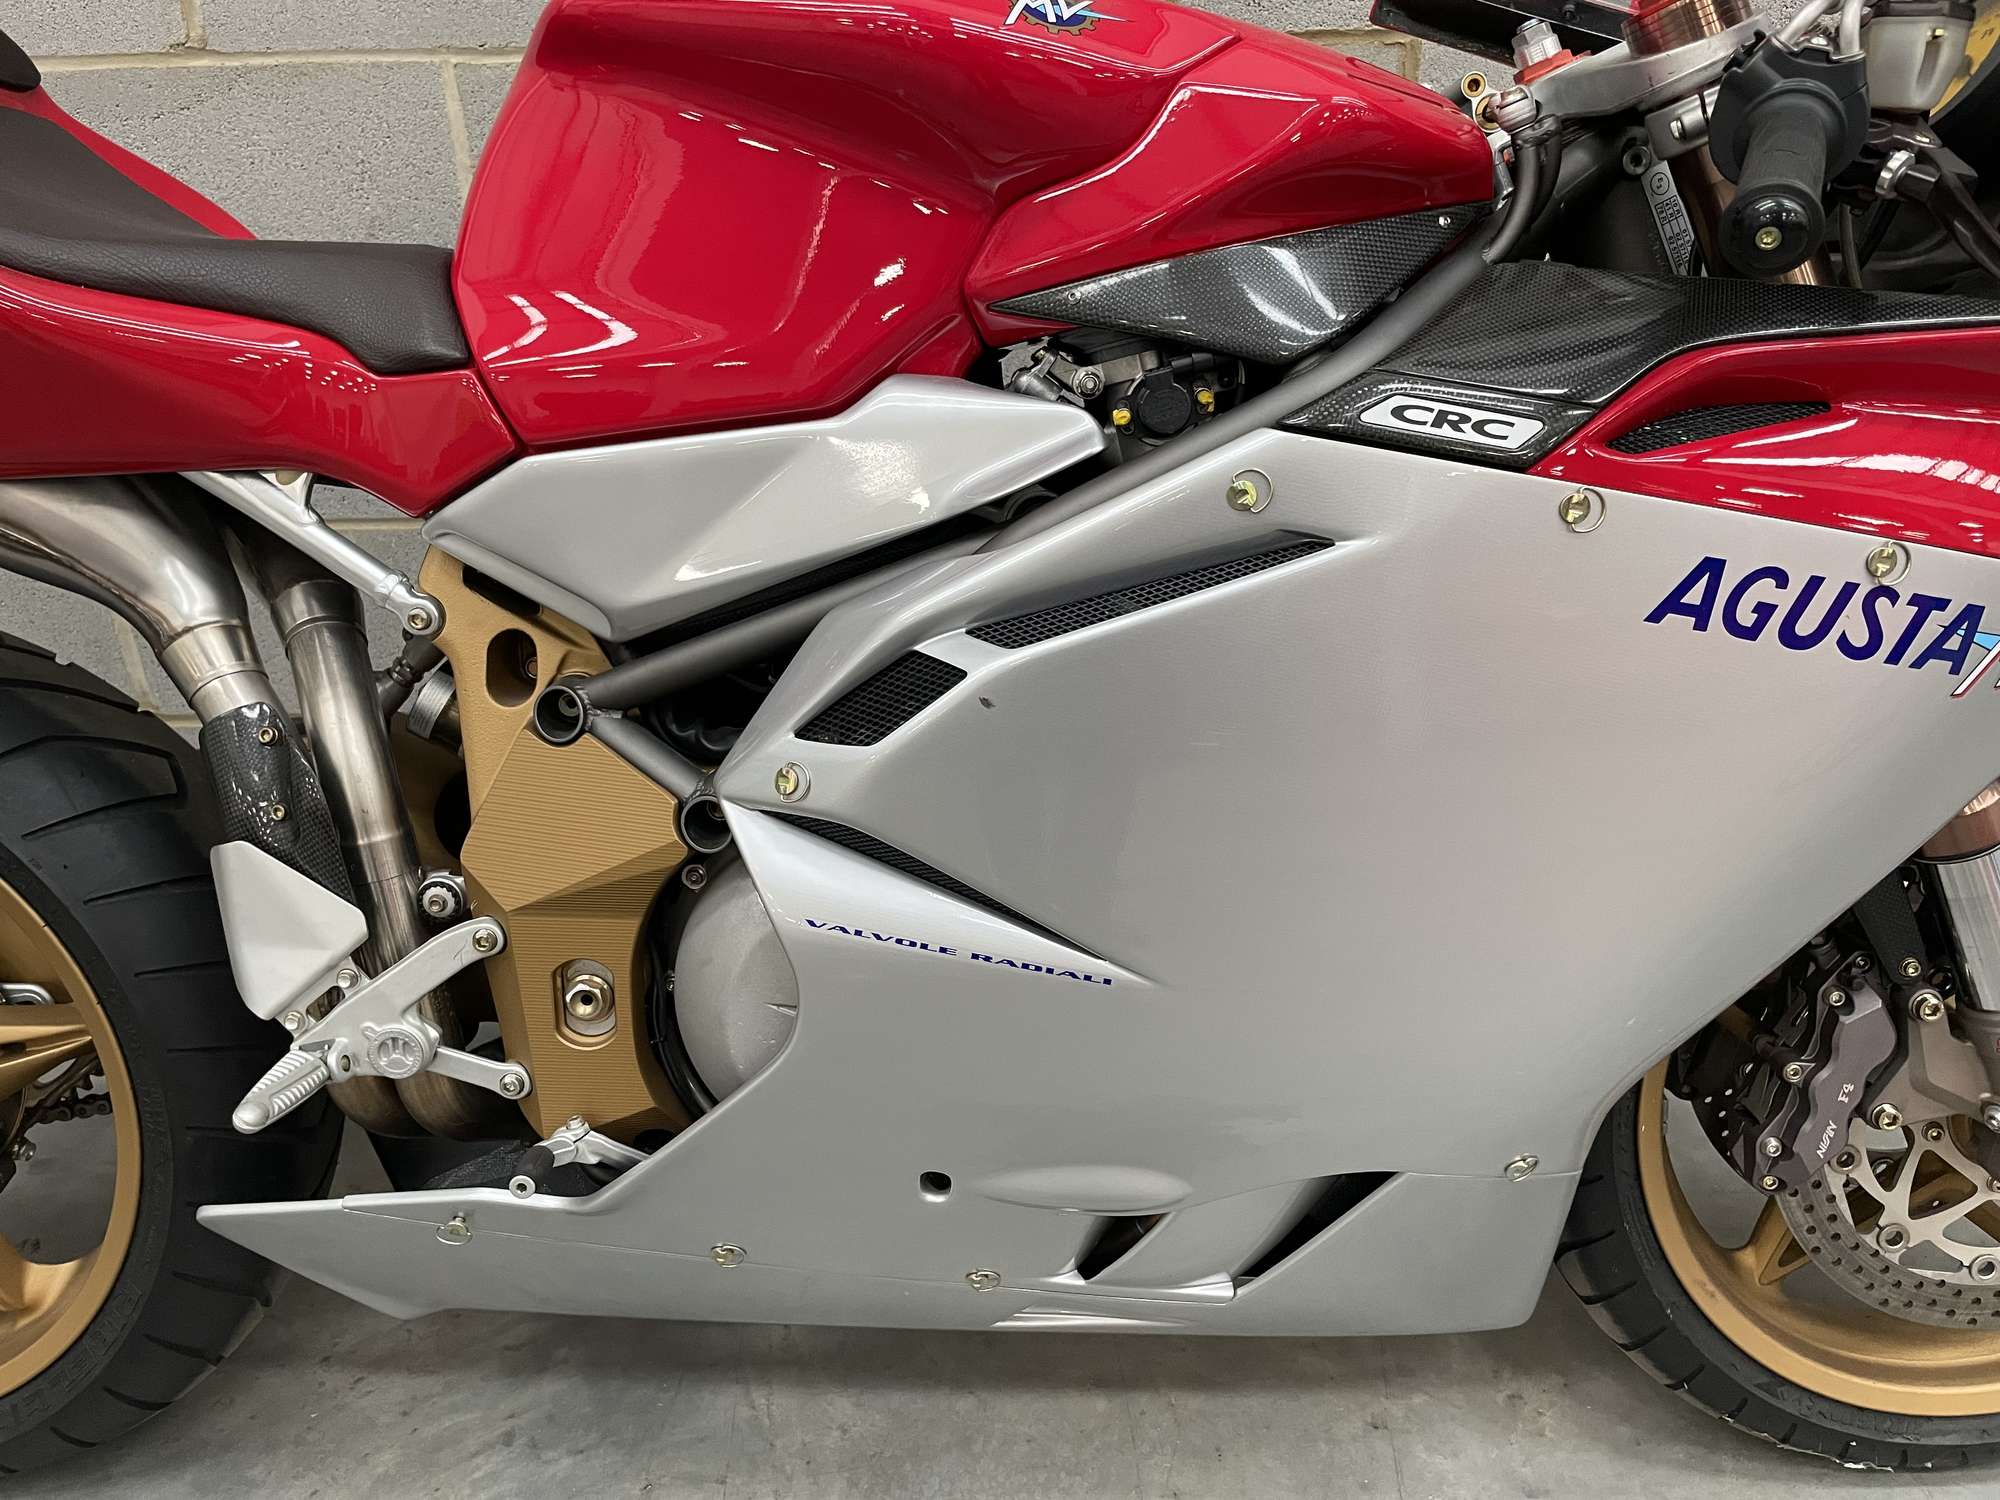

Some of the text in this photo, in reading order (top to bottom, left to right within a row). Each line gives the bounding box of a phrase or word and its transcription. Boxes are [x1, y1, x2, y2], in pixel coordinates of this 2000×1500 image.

[1390, 404, 1516, 441] CRC
[1643, 556, 1986, 676] AGUSTA
[805, 918, 1113, 986] VALVOLE RADIALI
